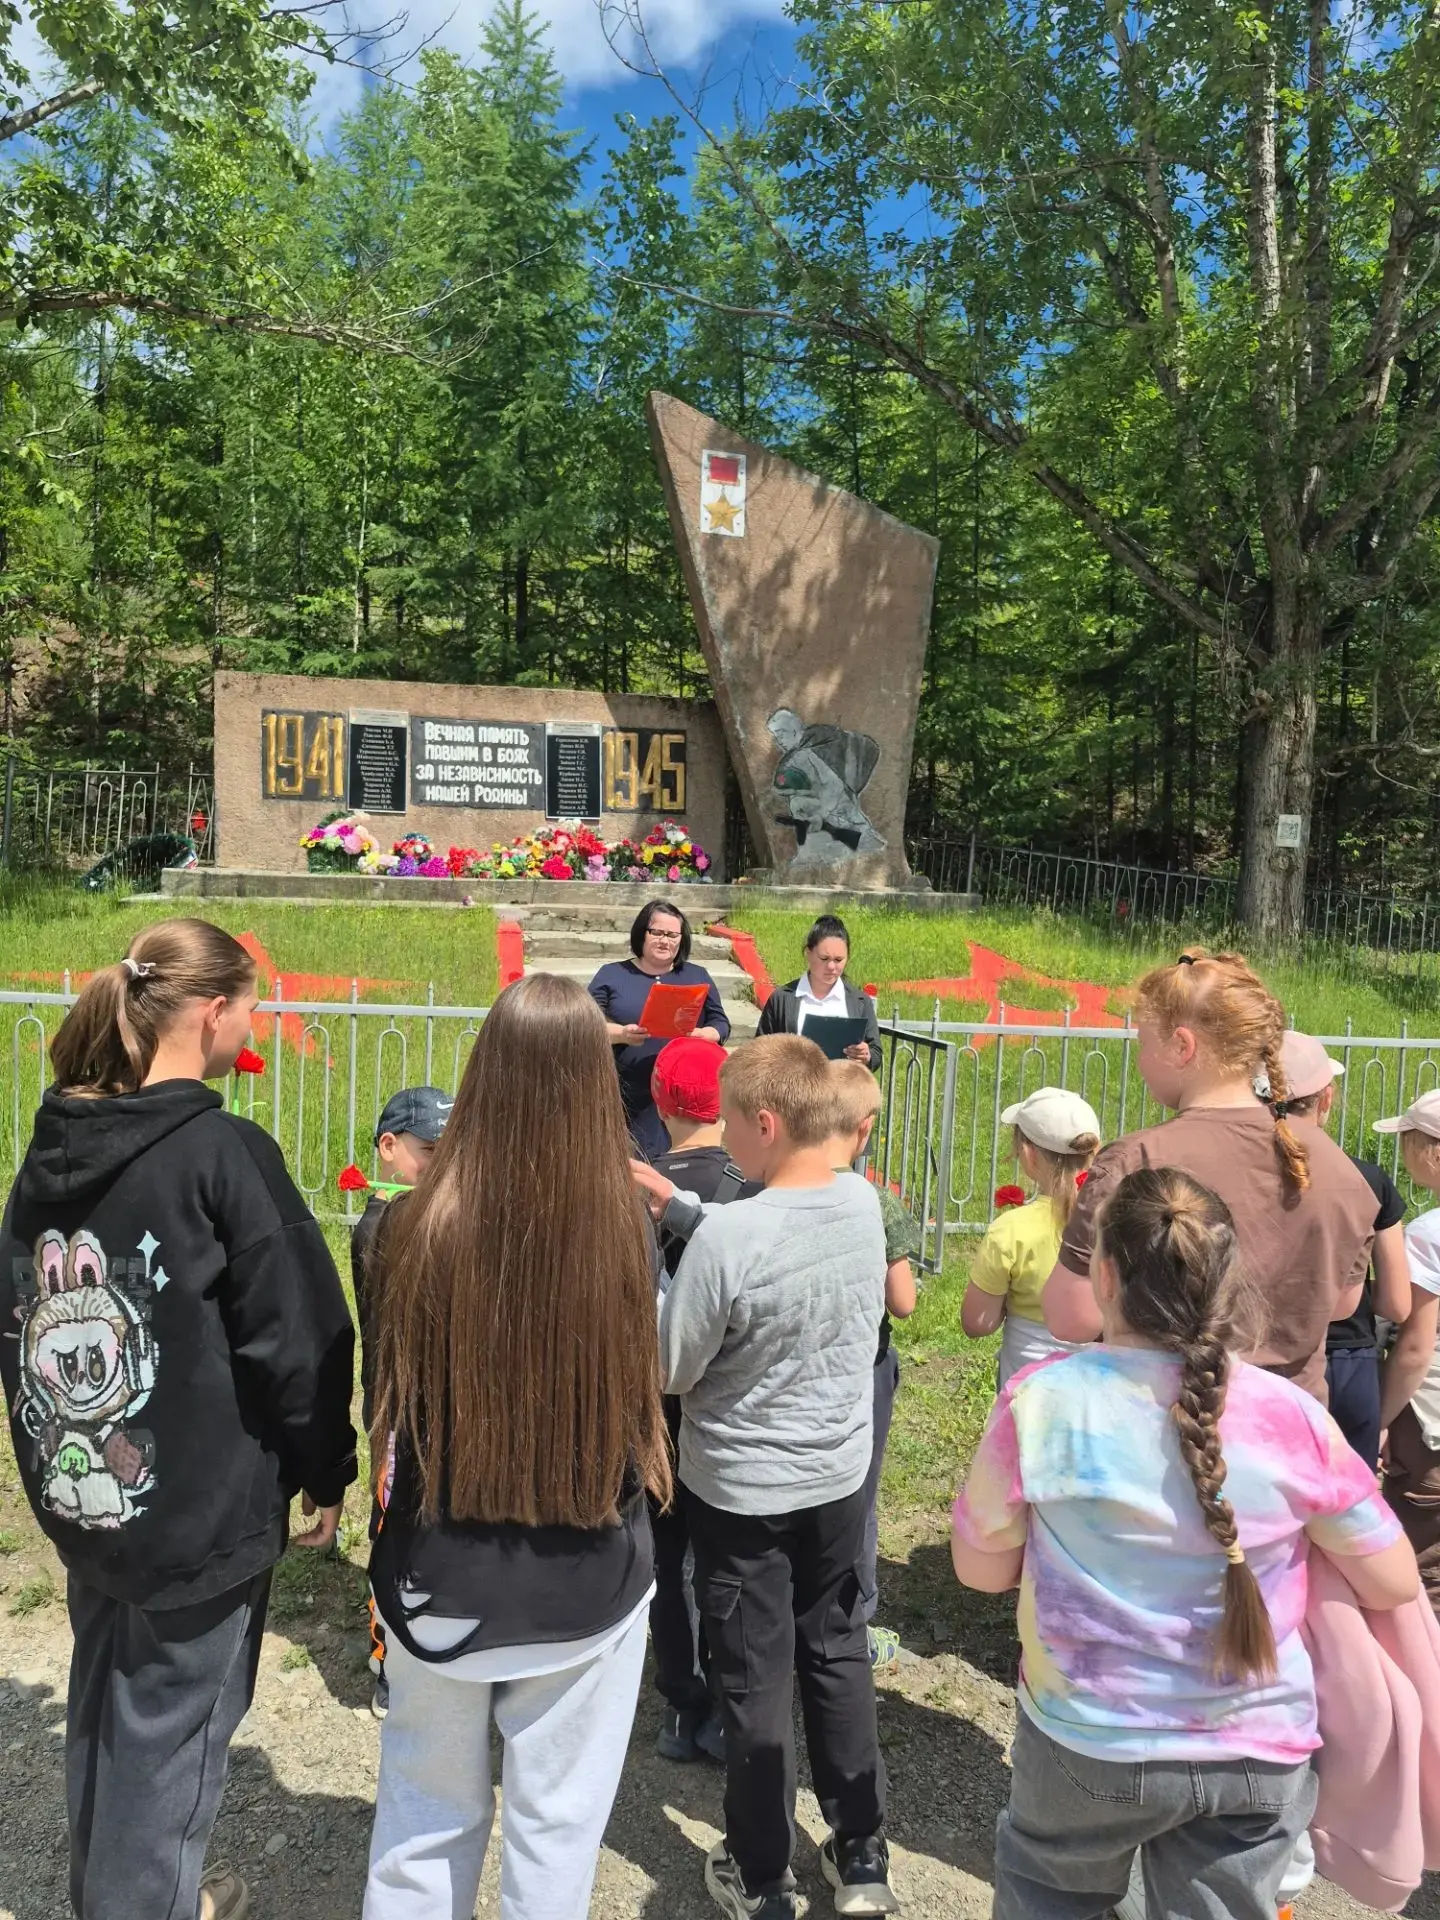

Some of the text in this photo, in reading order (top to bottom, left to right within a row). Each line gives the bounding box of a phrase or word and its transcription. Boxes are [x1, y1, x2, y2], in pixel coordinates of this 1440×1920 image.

[478, 726, 530, 745] ПАМЯТЬ
[262, 713, 344, 798] 1941
[482, 747, 493, 763] В
[497, 747, 530, 764] БОЯХ
[415, 764, 543, 785] ЗА НЕЗАВИСИМОСТЬ
[602, 731, 685, 810] 1945
[425, 783, 470, 803] НАШЕЙ
